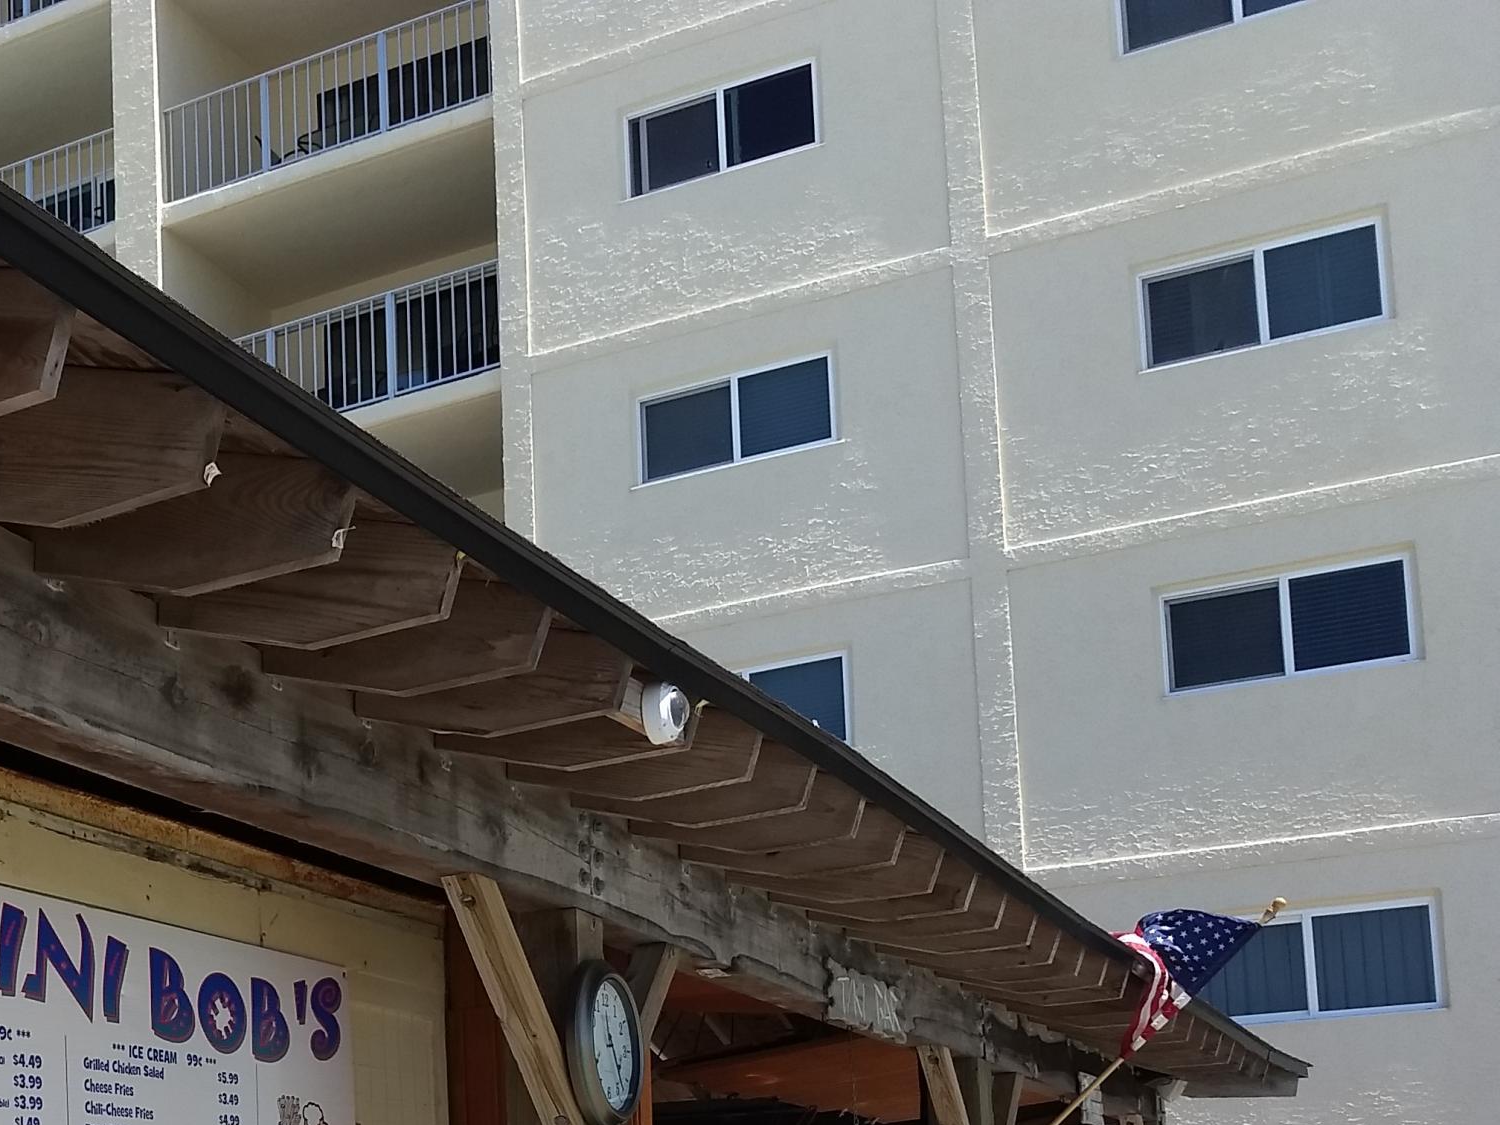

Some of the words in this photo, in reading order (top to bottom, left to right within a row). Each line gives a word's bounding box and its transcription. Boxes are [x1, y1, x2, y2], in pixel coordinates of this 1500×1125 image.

[149, 947, 342, 1062] BOB'S
[12, 1053, 43, 1070] $4.49
[128, 1044, 144, 1060] ICE
[146, 1047, 178, 1065] CREAM
[13, 1073, 43, 1090] $3.99
[83, 1077, 113, 1095] Cheese
[114, 1082, 134, 1097] Fries
[218, 1092, 239, 1106] $3.49
[13, 1094, 44, 1111] $3.99
